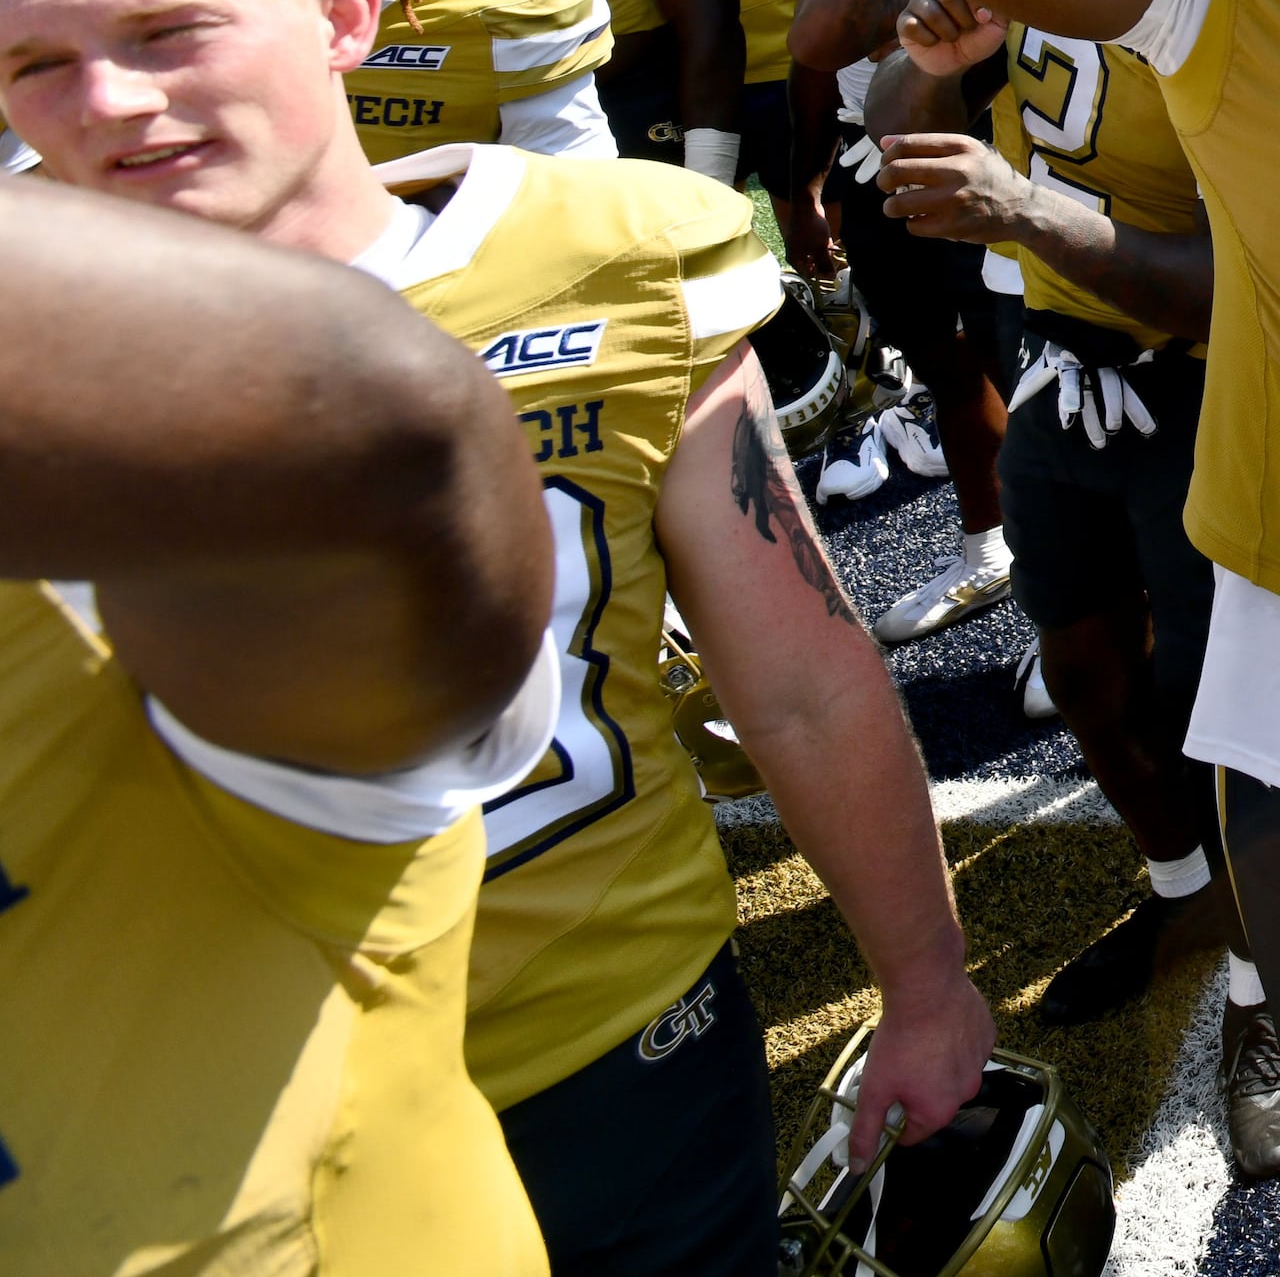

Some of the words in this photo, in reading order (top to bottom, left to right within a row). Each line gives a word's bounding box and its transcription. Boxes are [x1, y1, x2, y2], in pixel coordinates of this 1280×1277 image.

[362, 46, 447, 69] ACC
[482, 324, 601, 374] ACC
[778, 371, 840, 428] JACKET
[518, 400, 605, 463] CH
[635, 977, 717, 1064] GT
[1022, 1138, 1052, 1200] ACC
